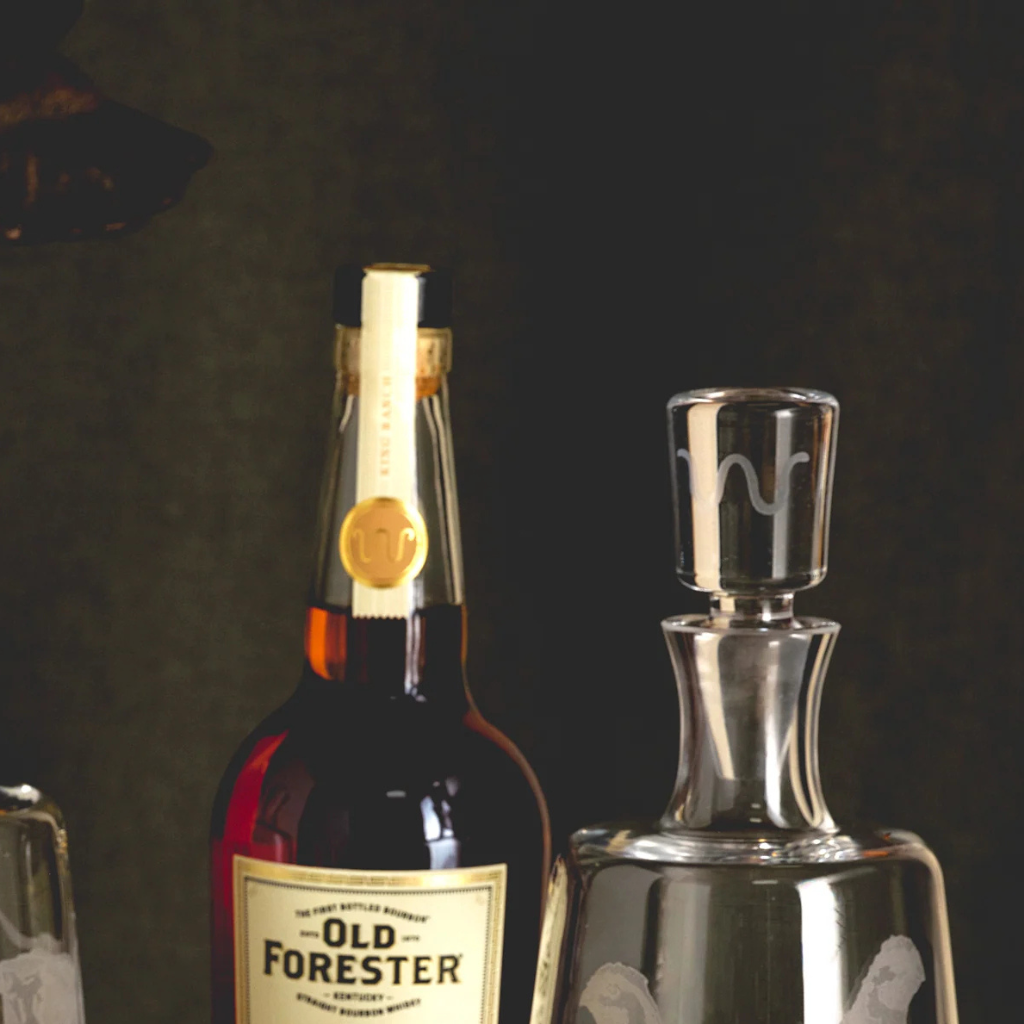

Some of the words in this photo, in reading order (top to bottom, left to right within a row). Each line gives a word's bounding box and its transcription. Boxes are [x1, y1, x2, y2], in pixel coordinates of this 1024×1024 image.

[295, 908, 311, 919] THE
[313, 904, 337, 917] FIRST
[340, 902, 381, 914] BOTTLED
[384, 906, 428, 924] BOURBON
[323, 917, 396, 950] OLD
[263, 939, 461, 986] FORESTER
[296, 992, 338, 1014] STRAIGHT
[340, 1006, 385, 1018] BOURBON
[333, 991, 385, 1002] KENTUCKY
